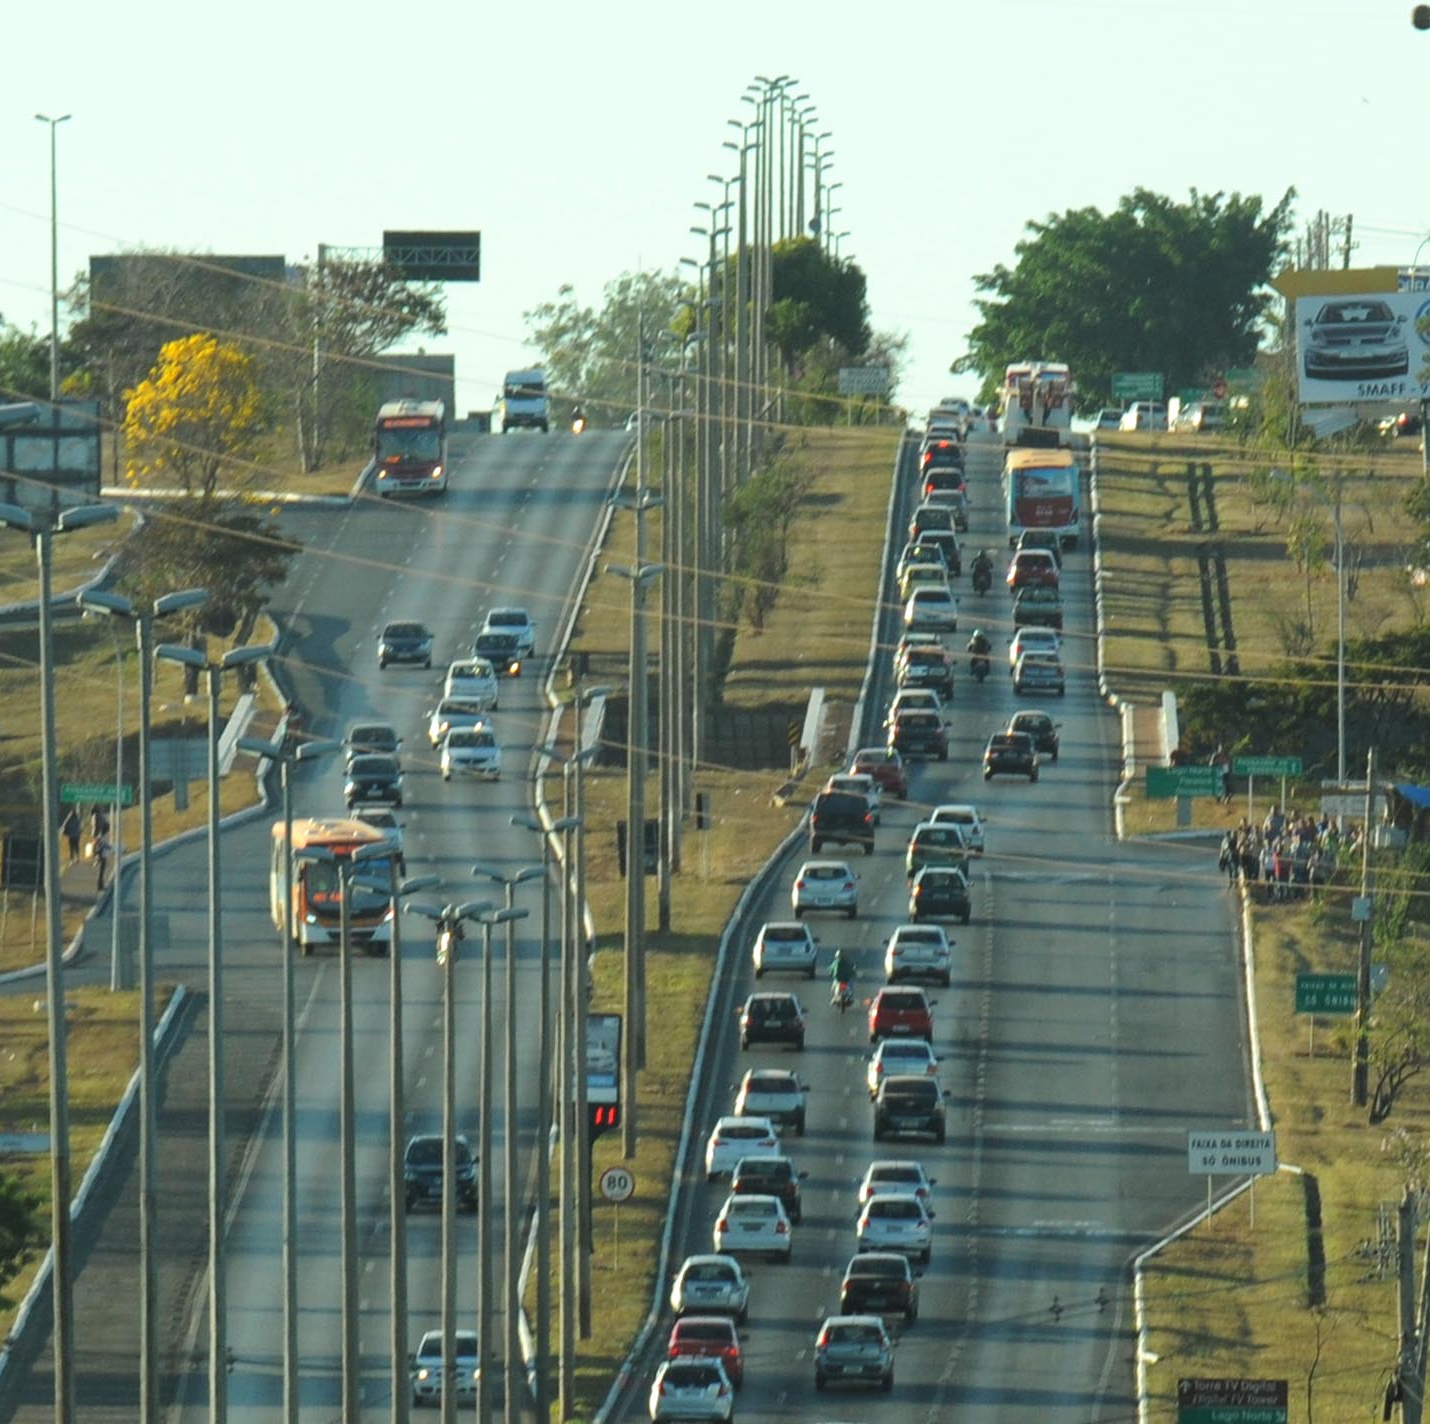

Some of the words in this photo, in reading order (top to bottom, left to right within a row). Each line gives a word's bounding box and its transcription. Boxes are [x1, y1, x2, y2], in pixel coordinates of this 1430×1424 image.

[1357, 383, 1405, 397] SMAFF
[1191, 1139, 1217, 1149] FAIXA
[1220, 1139, 1232, 1149] DA
[1235, 1139, 1270, 1149] DIREITA
[1222, 1155, 1261, 1166] ÔNIBUS
[607, 1175, 628, 1191] 80
